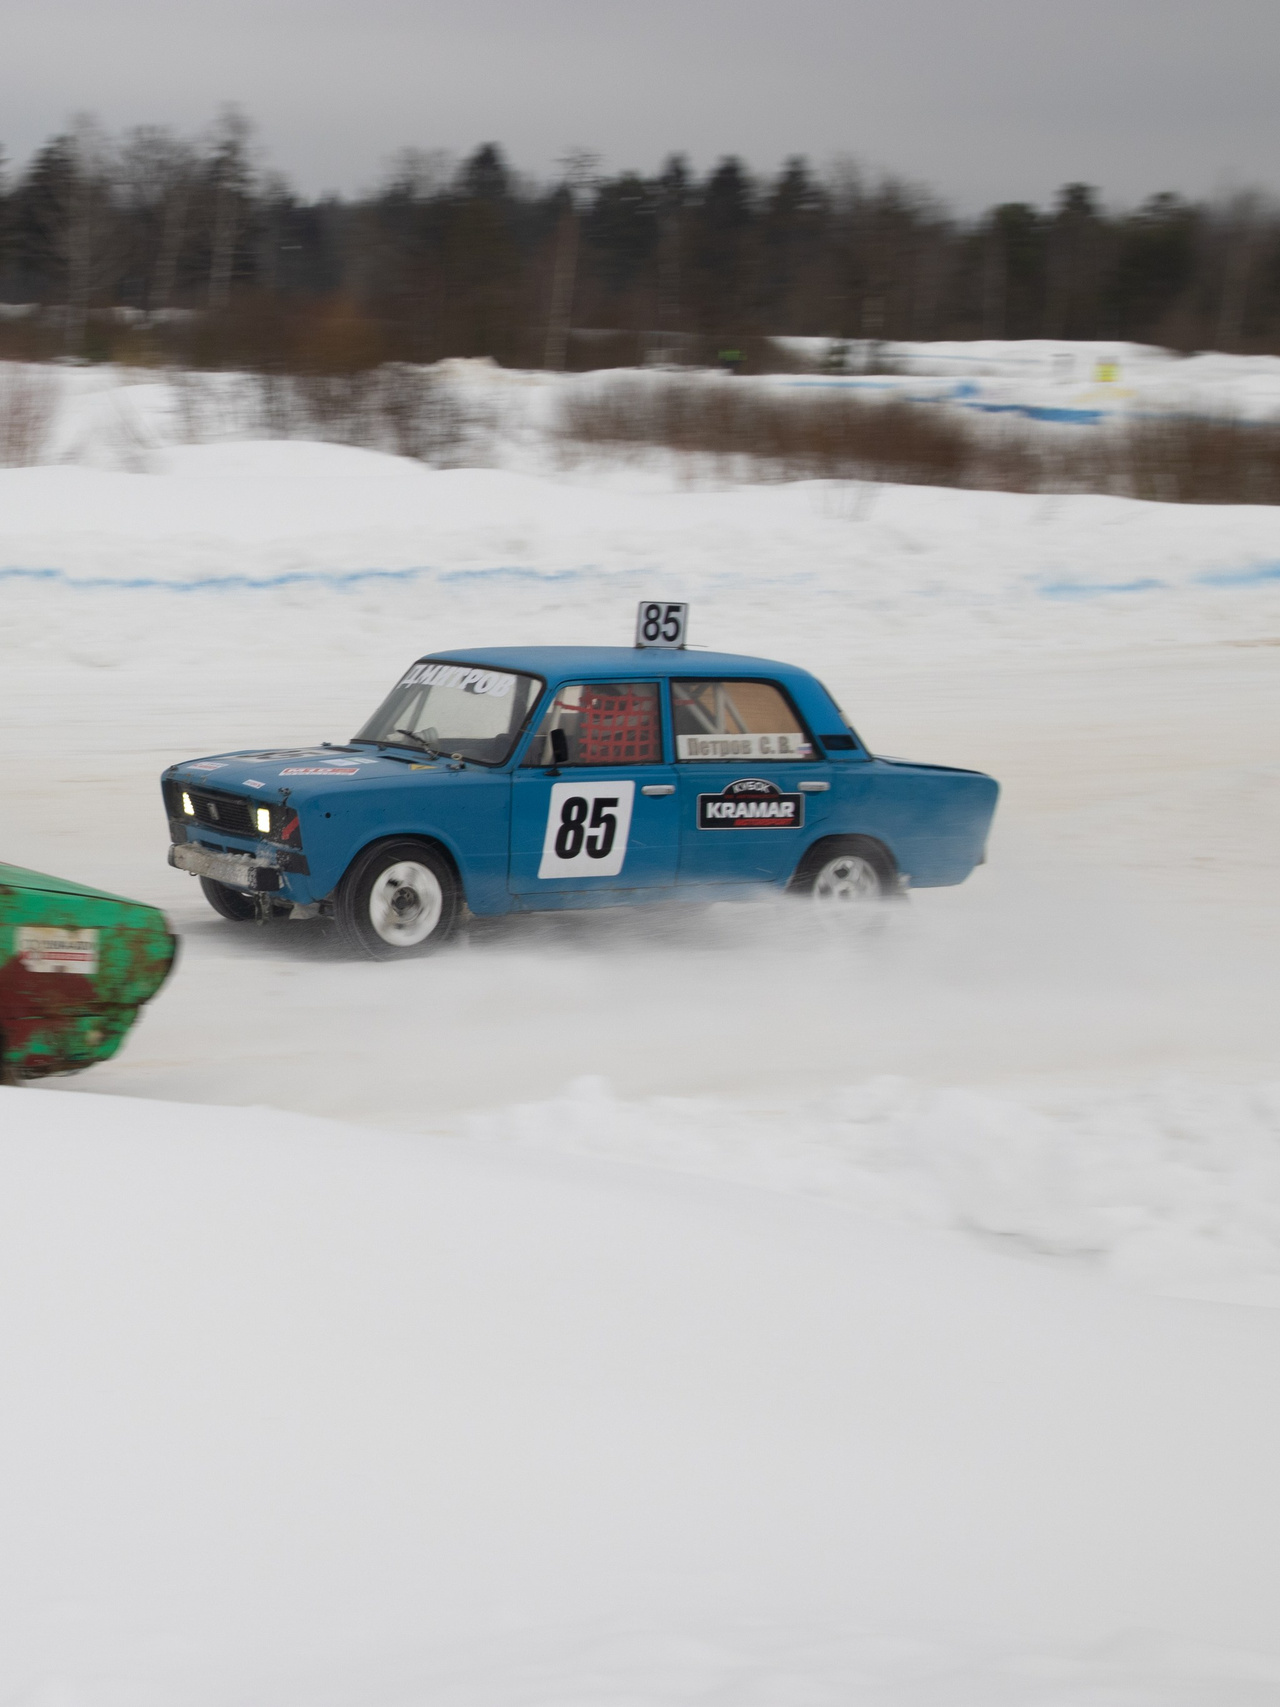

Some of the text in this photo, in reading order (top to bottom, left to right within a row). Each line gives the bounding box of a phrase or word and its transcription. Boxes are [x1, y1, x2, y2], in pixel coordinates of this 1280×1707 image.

[643, 604, 681, 642] 85
[397, 664, 516, 697] ДМИТРОВ
[687, 737, 752, 757] Петров
[706, 801, 795, 819] KRAMAR
[554, 796, 620, 860] 85
